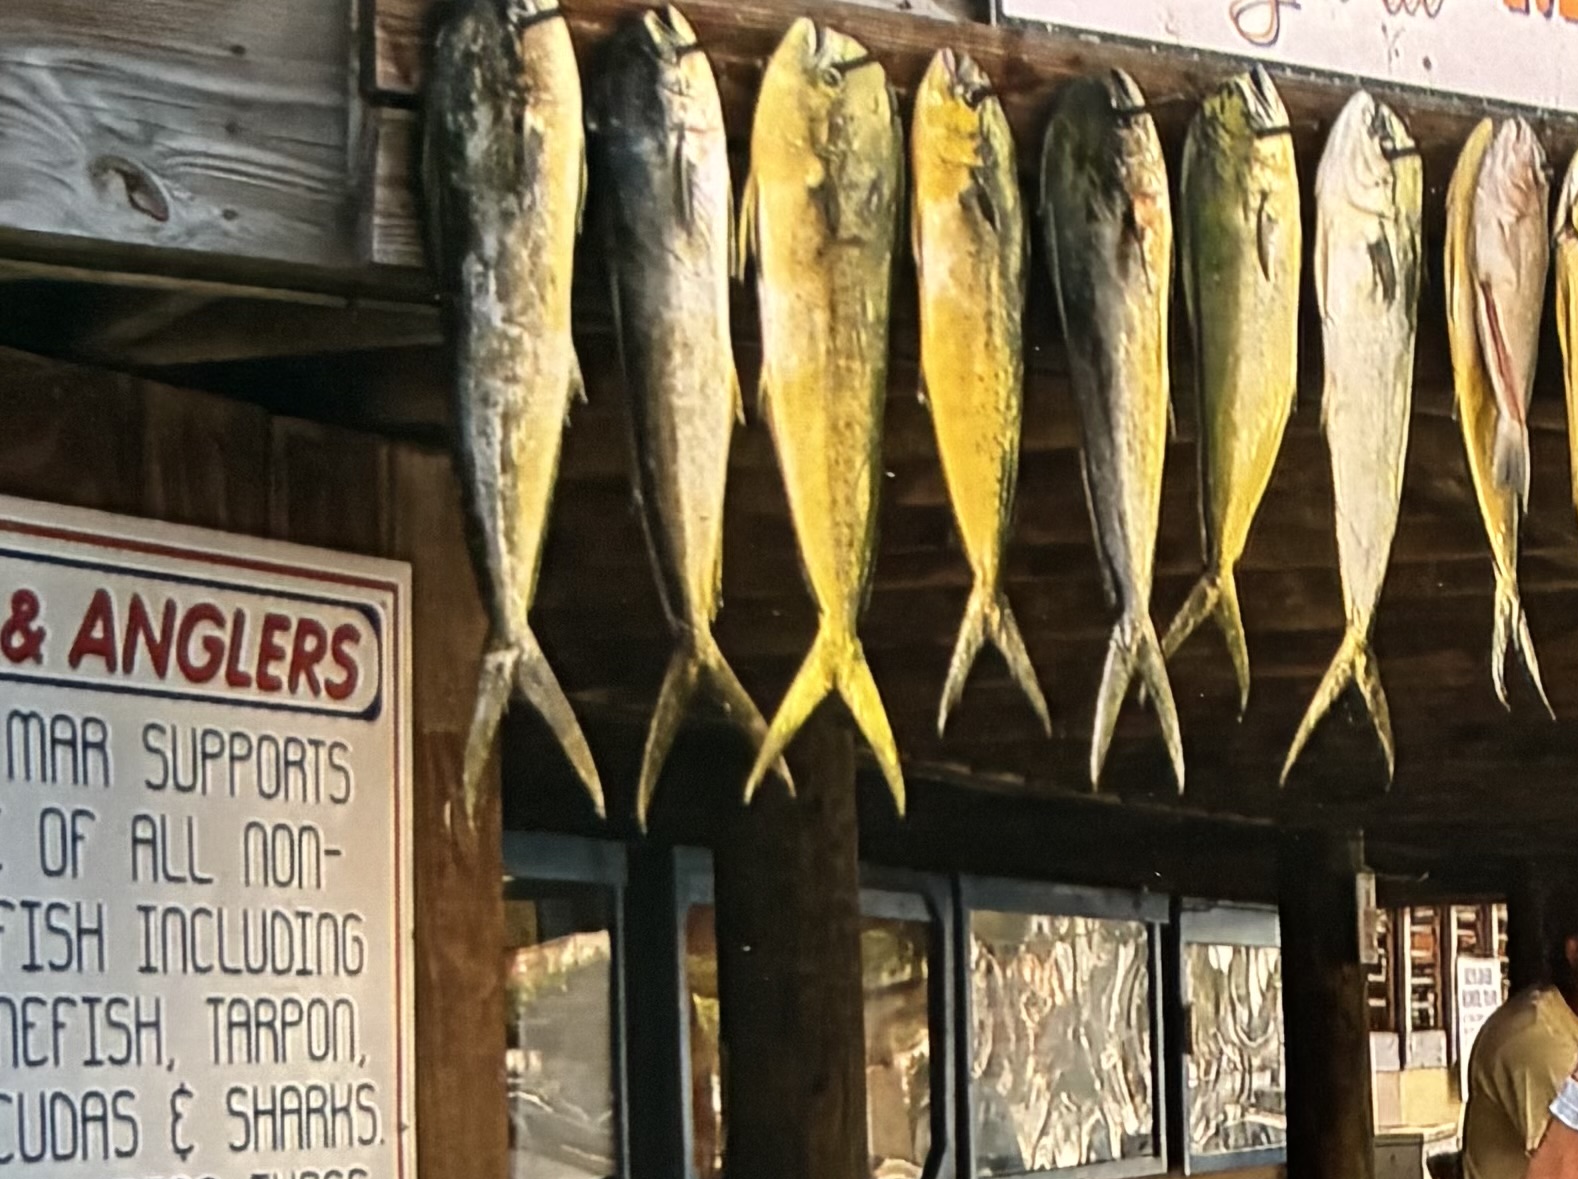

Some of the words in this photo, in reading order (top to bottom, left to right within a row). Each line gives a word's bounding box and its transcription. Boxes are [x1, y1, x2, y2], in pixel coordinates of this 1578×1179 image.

[0, 588, 46, 665] &
[68, 588, 362, 701] ANGLERS
[7, 709, 110, 788] MAR
[142, 722, 353, 805] SUPPORTS
[39, 807, 96, 879] OF
[131, 814, 213, 885] ALL
[244, 822, 342, 889] NON-
[138, 904, 365, 977] INCLUDING
[207, 997, 366, 1069] TARPON,
[170, 1083, 194, 1162] &
[226, 1083, 384, 1151] SHARKS.
